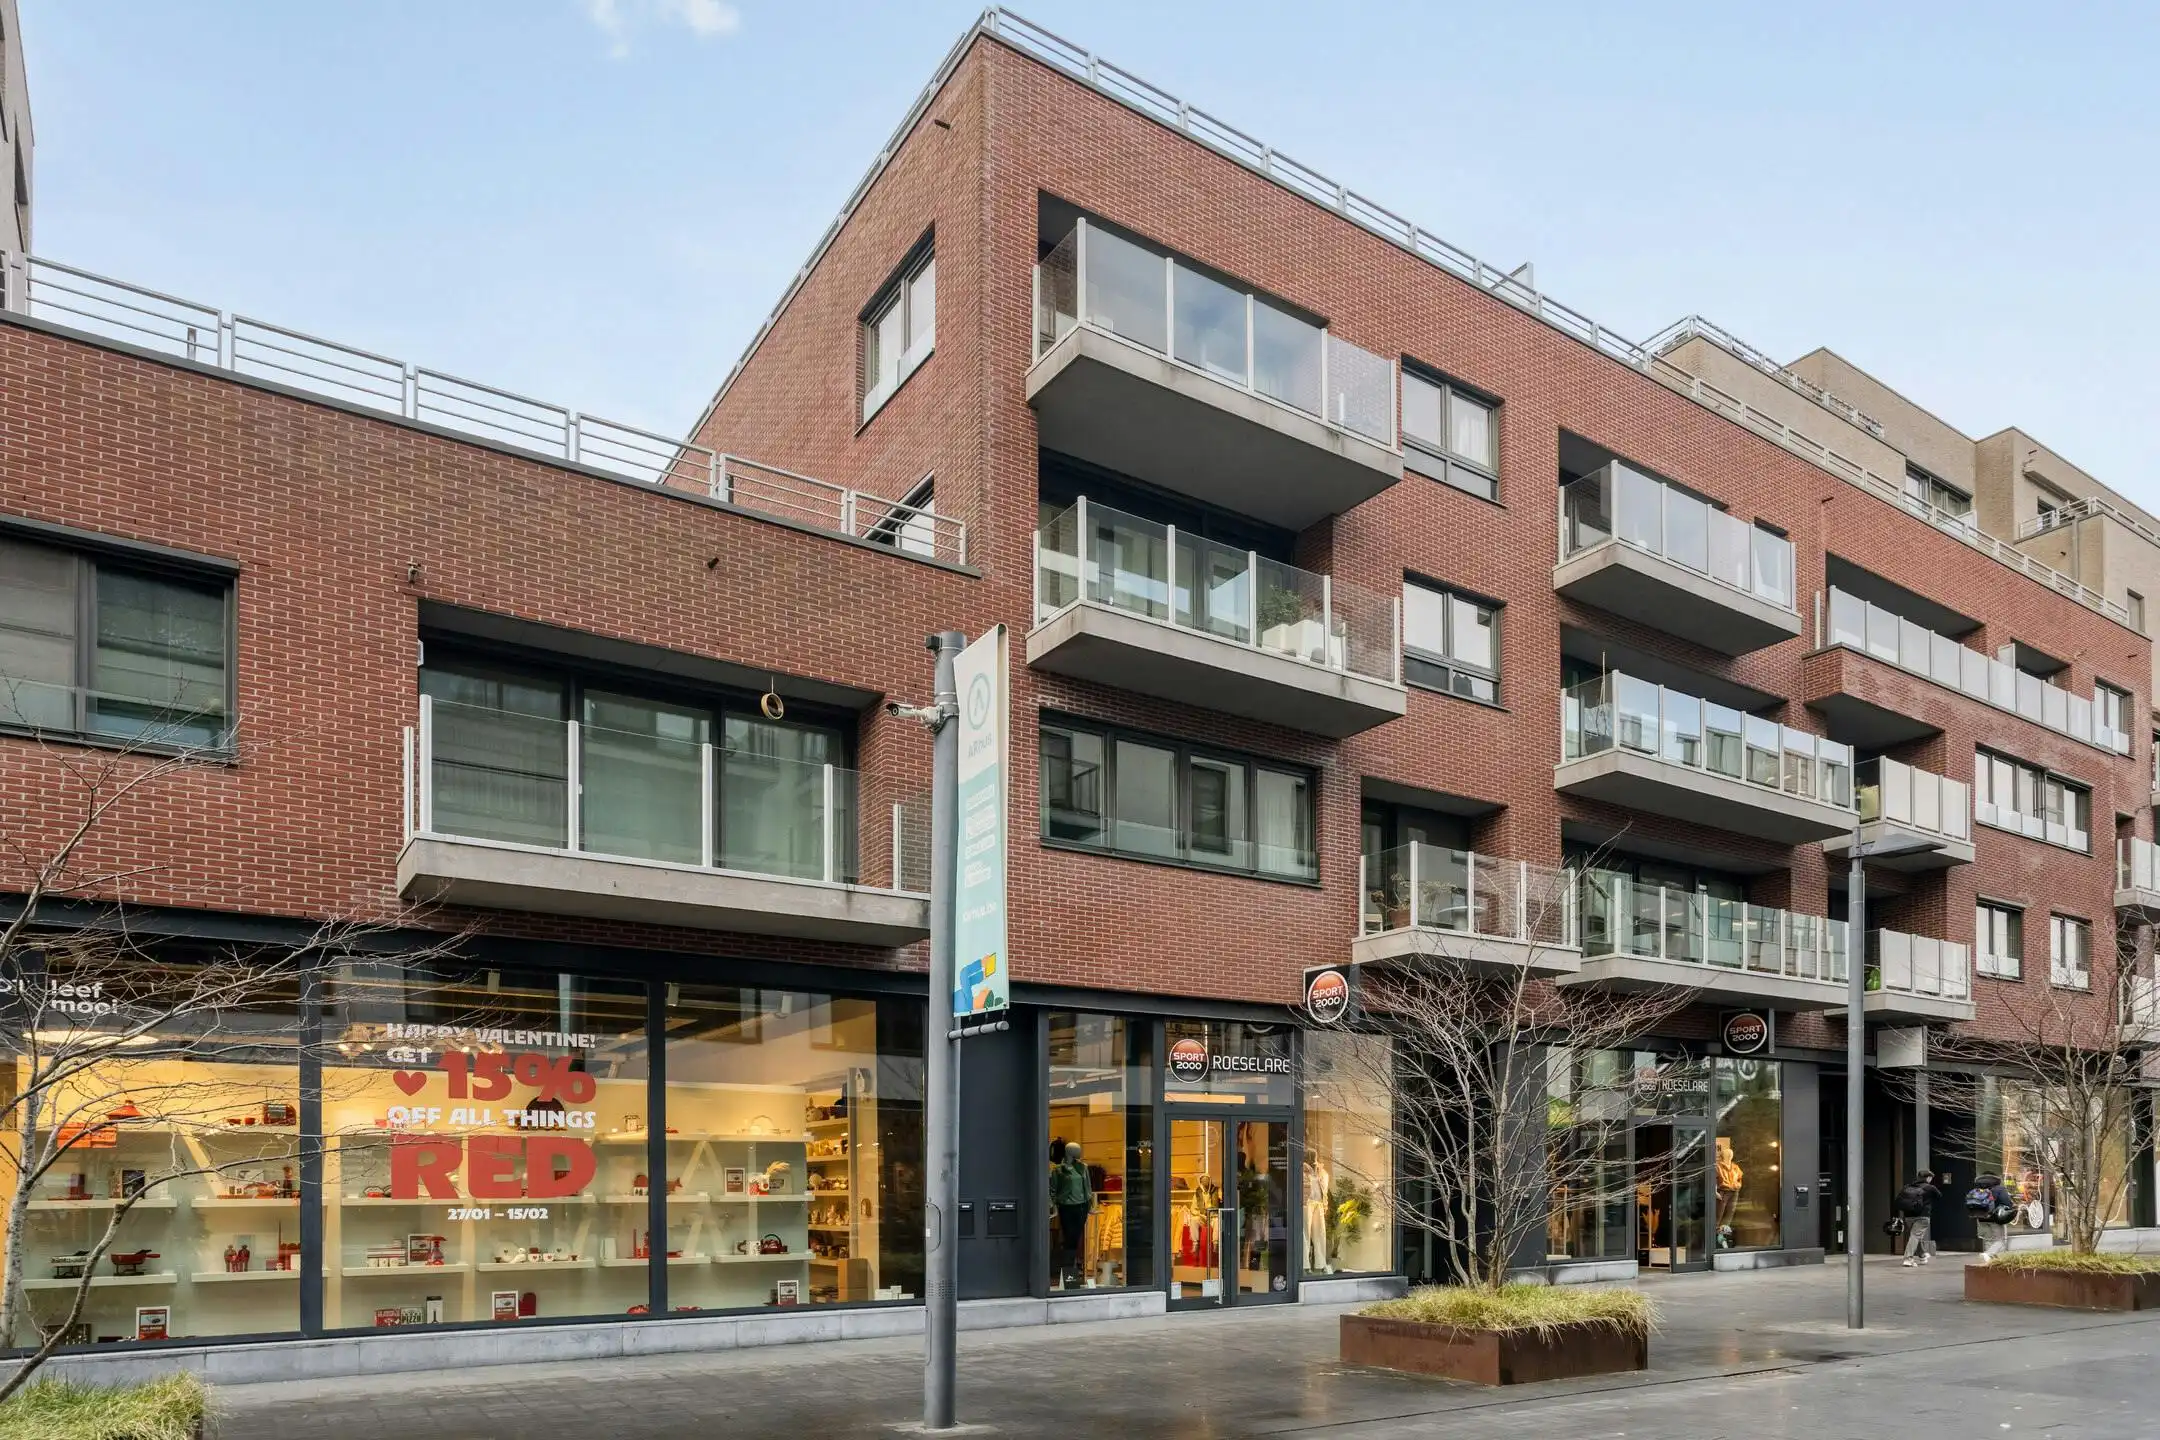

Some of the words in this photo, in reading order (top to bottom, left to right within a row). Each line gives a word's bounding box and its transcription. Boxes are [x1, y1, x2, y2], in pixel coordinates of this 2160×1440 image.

[51, 980, 104, 998] leef
[1312, 985, 1344, 998] SPORT
[51, 999, 118, 1014] mooi
[1315, 996, 1341, 1008] 2000
[386, 1023, 468, 1041] HAPPY
[475, 1028, 596, 1048] VALENTINE!
[1729, 1024, 1763, 1034] SPORT
[1732, 1032, 1759, 1042] 2000
[1173, 1052, 1205, 1062] SPORT
[1212, 1055, 1291, 1073] ROESELARE
[1176, 1061, 1202, 1070] 2000
[386, 1046, 433, 1063] GET
[436, 1050, 597, 1104] 15%
[1662, 1079, 1709, 1093] ROESELARE
[387, 1105, 442, 1125] OFF
[448, 1107, 497, 1126] ALL
[503, 1109, 596, 1129] THINGS
[390, 1133, 597, 1200] RED
[447, 1208, 490, 1220] 27/01
[507, 1207, 549, 1220] 15/02
